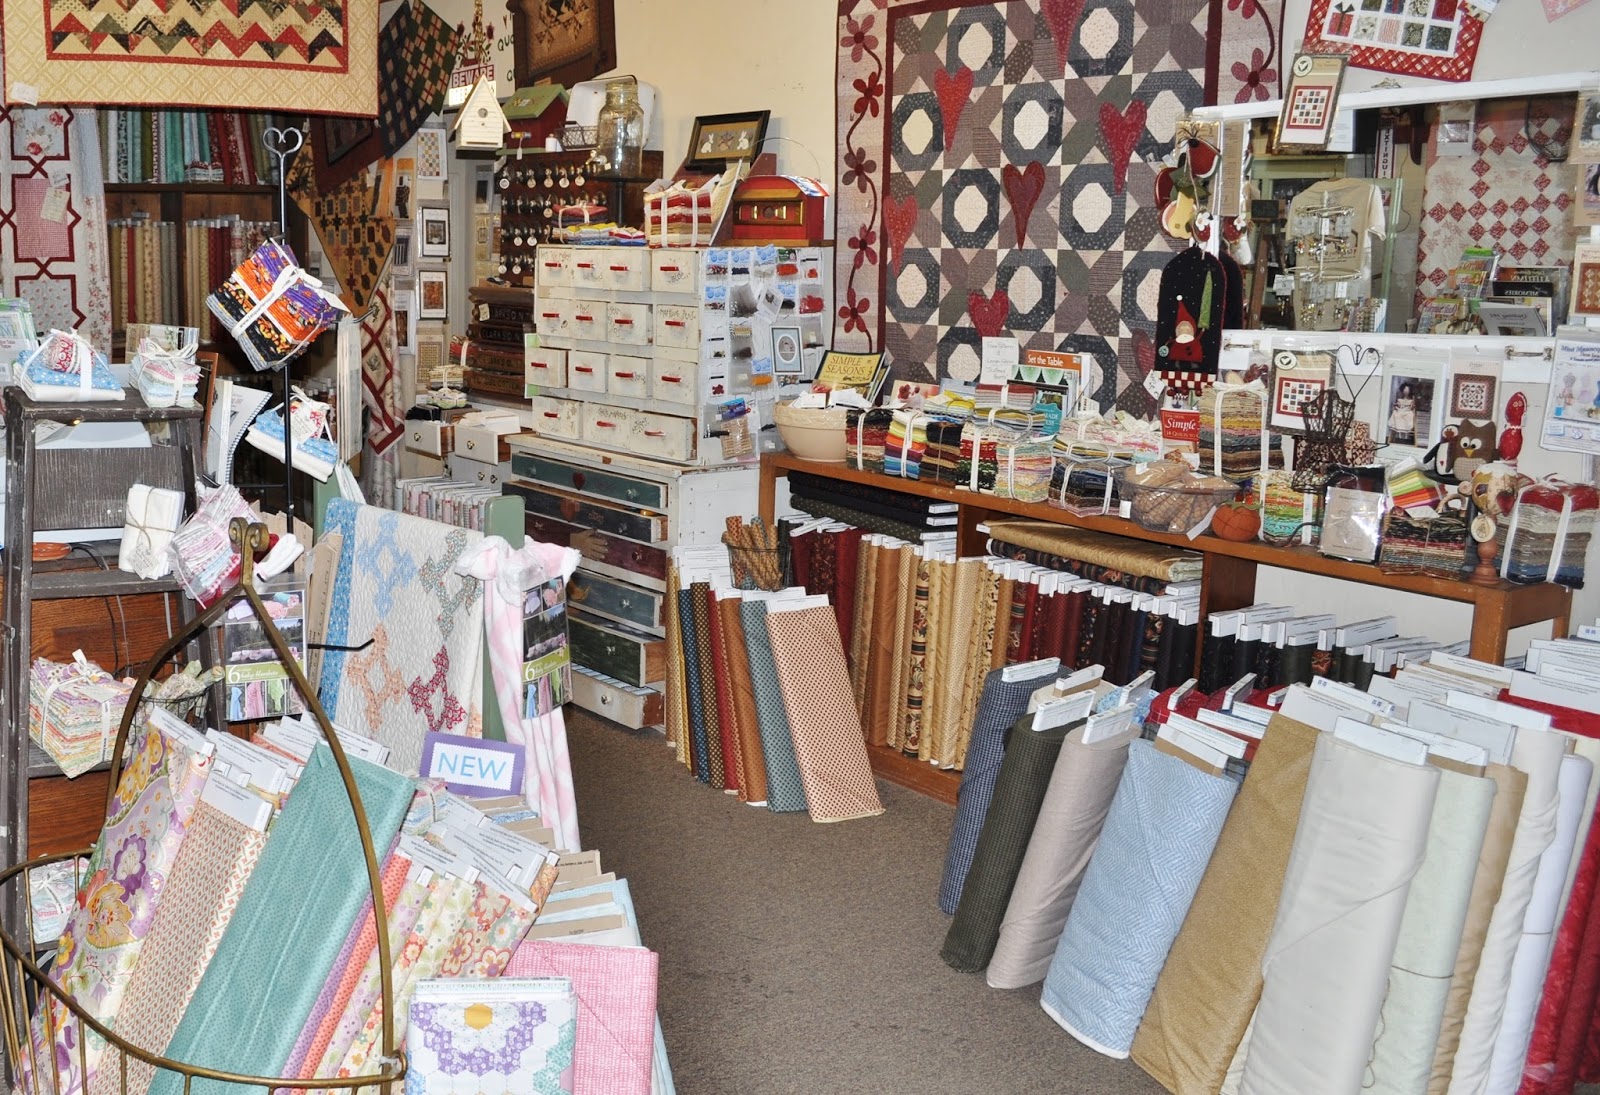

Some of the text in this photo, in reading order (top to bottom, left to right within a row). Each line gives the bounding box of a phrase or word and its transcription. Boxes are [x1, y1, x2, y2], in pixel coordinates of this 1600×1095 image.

[452, 65, 495, 88] BEWARE
[830, 355, 863, 366] SIMPLE
[1027, 354, 1064, 367] Set the Table
[826, 364, 866, 376] SEASONS
[1164, 417, 1197, 431] Simple
[228, 665, 241, 683] 6
[525, 661, 535, 681] 6
[437, 752, 507, 781] NEW
